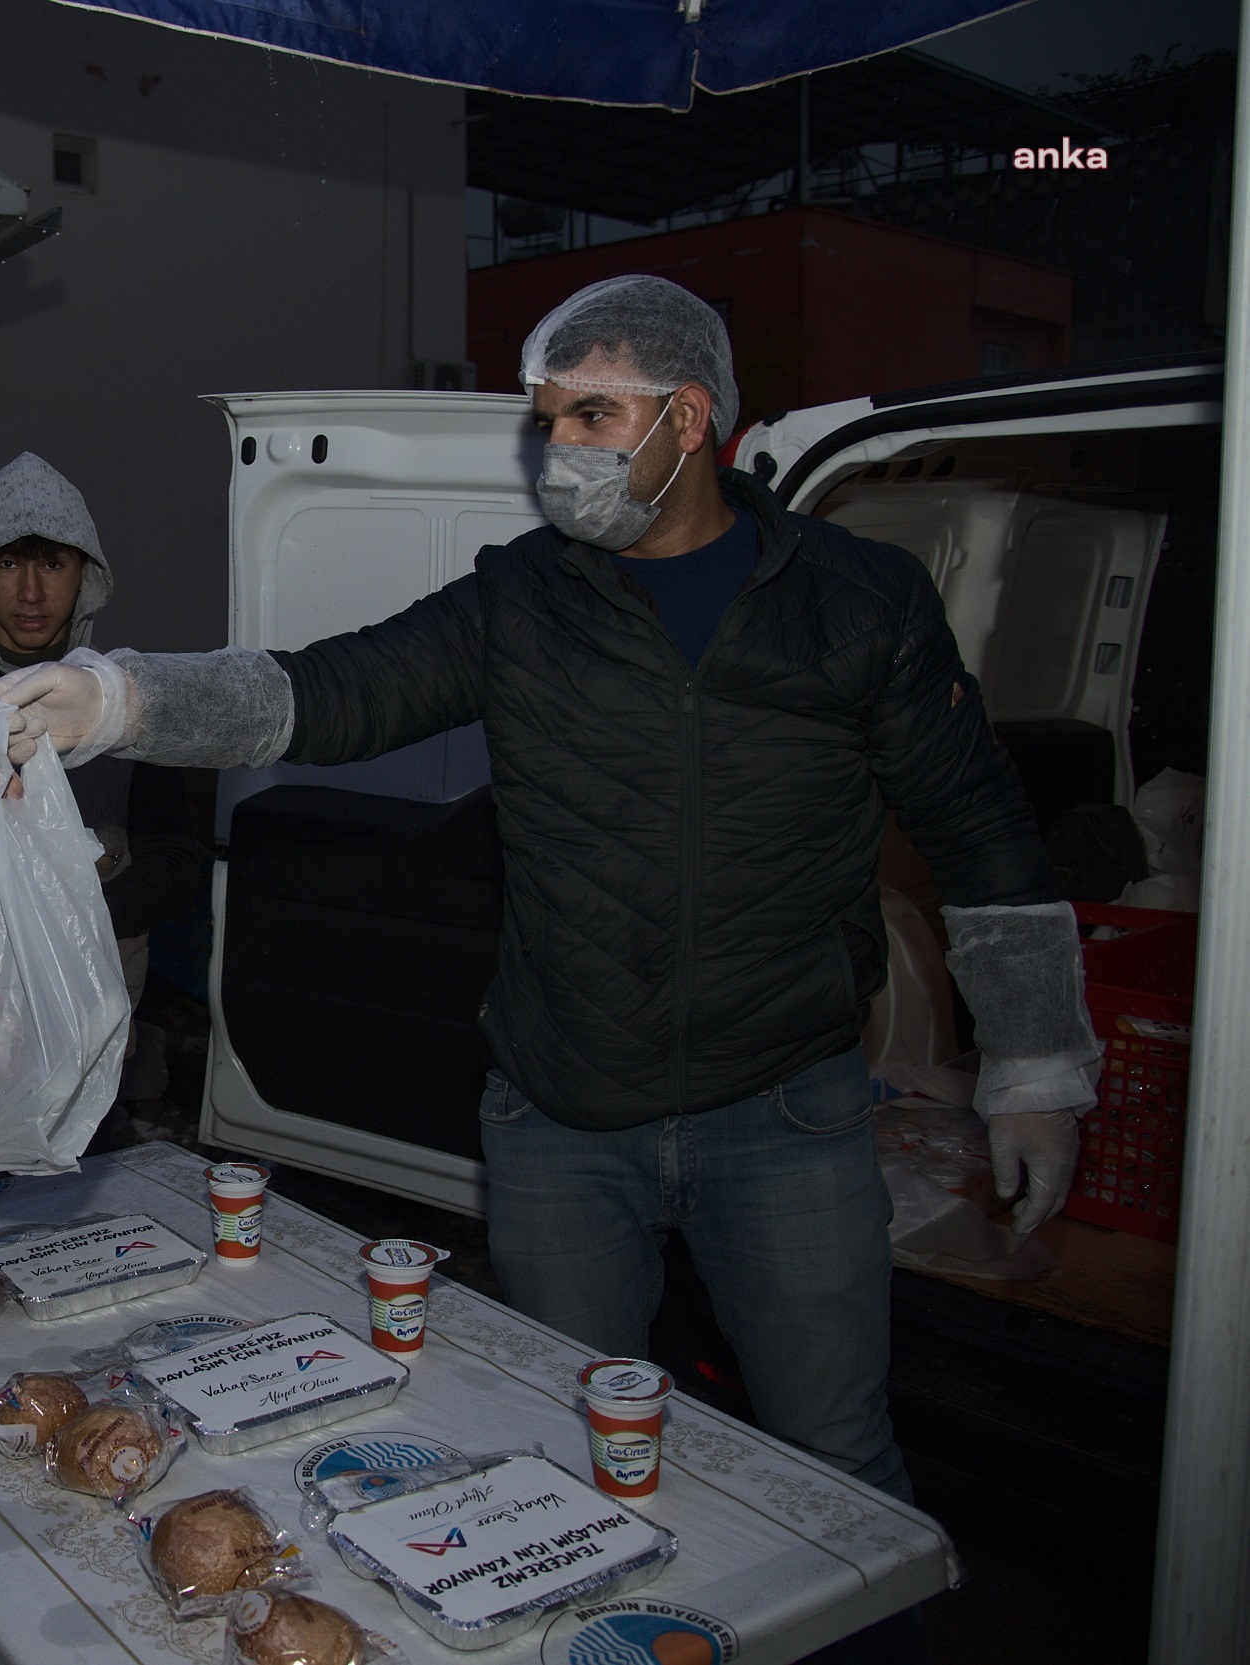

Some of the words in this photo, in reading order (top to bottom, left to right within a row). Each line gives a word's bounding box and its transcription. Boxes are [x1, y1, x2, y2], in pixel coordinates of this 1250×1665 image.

[26, 1227, 112, 1254] TENCEREMİZ
[61, 1239, 89, 1255] İÇİN
[93, 1223, 157, 1245] KAYNIYOR
[30, 1263, 72, 1277] Vahap
[396, 1325, 419, 1338] Ayran
[155, 1358, 228, 1386] PAYLAŞIM
[230, 1348, 263, 1366] İÇİN
[266, 1327, 337, 1352] KAYNIYOR
[187, 1331, 285, 1366] TENCEREMİZ
[200, 1380, 249, 1398] Vahap
[299, 1375, 340, 1394] Olsun
[302, 1439, 351, 1478] BELEDİYESİ
[615, 1468, 646, 1481] Ayran
[409, 1501, 454, 1521] Olsun
[513, 1491, 567, 1516] Vahap
[552, 1512, 631, 1551] PAYLAŞIM
[516, 1539, 548, 1561] İÇİN
[422, 1553, 513, 1597] KAYNIYOR
[490, 1543, 606, 1590] TENCEREMİZ
[574, 1601, 640, 1622] MERSİN
